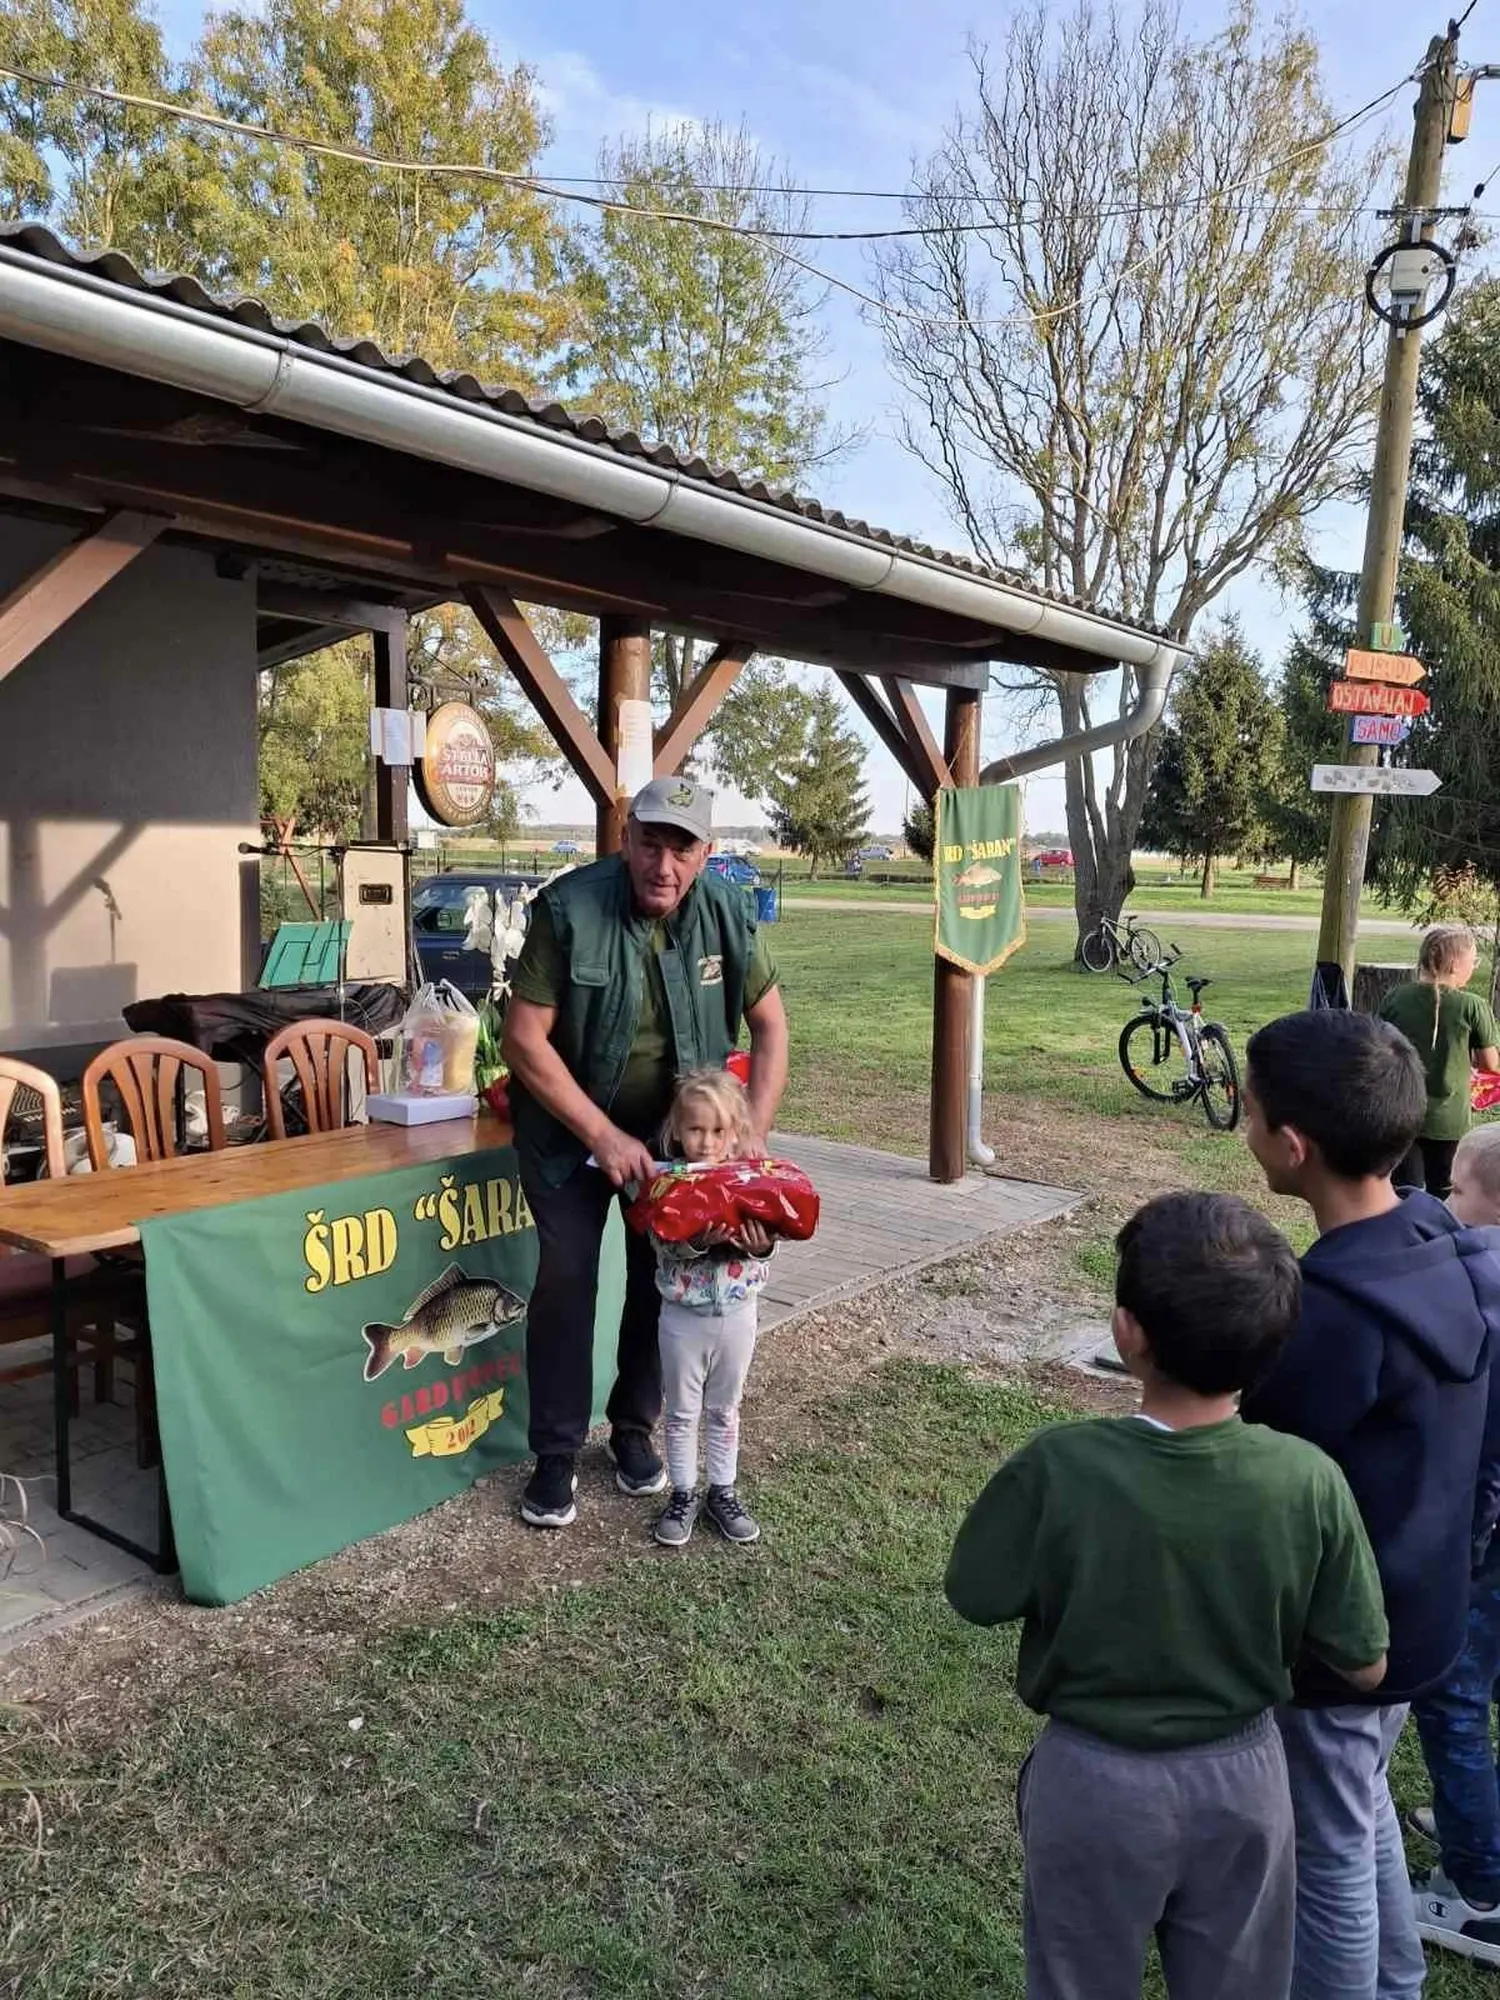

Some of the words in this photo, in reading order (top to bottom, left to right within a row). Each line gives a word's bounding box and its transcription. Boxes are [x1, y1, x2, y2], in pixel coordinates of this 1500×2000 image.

[1357, 719, 1400, 741] SAMO
[303, 1207, 398, 1293] ŠRD
[413, 1174, 536, 1250] “ŠARA
[446, 1419, 477, 1448] 2012
